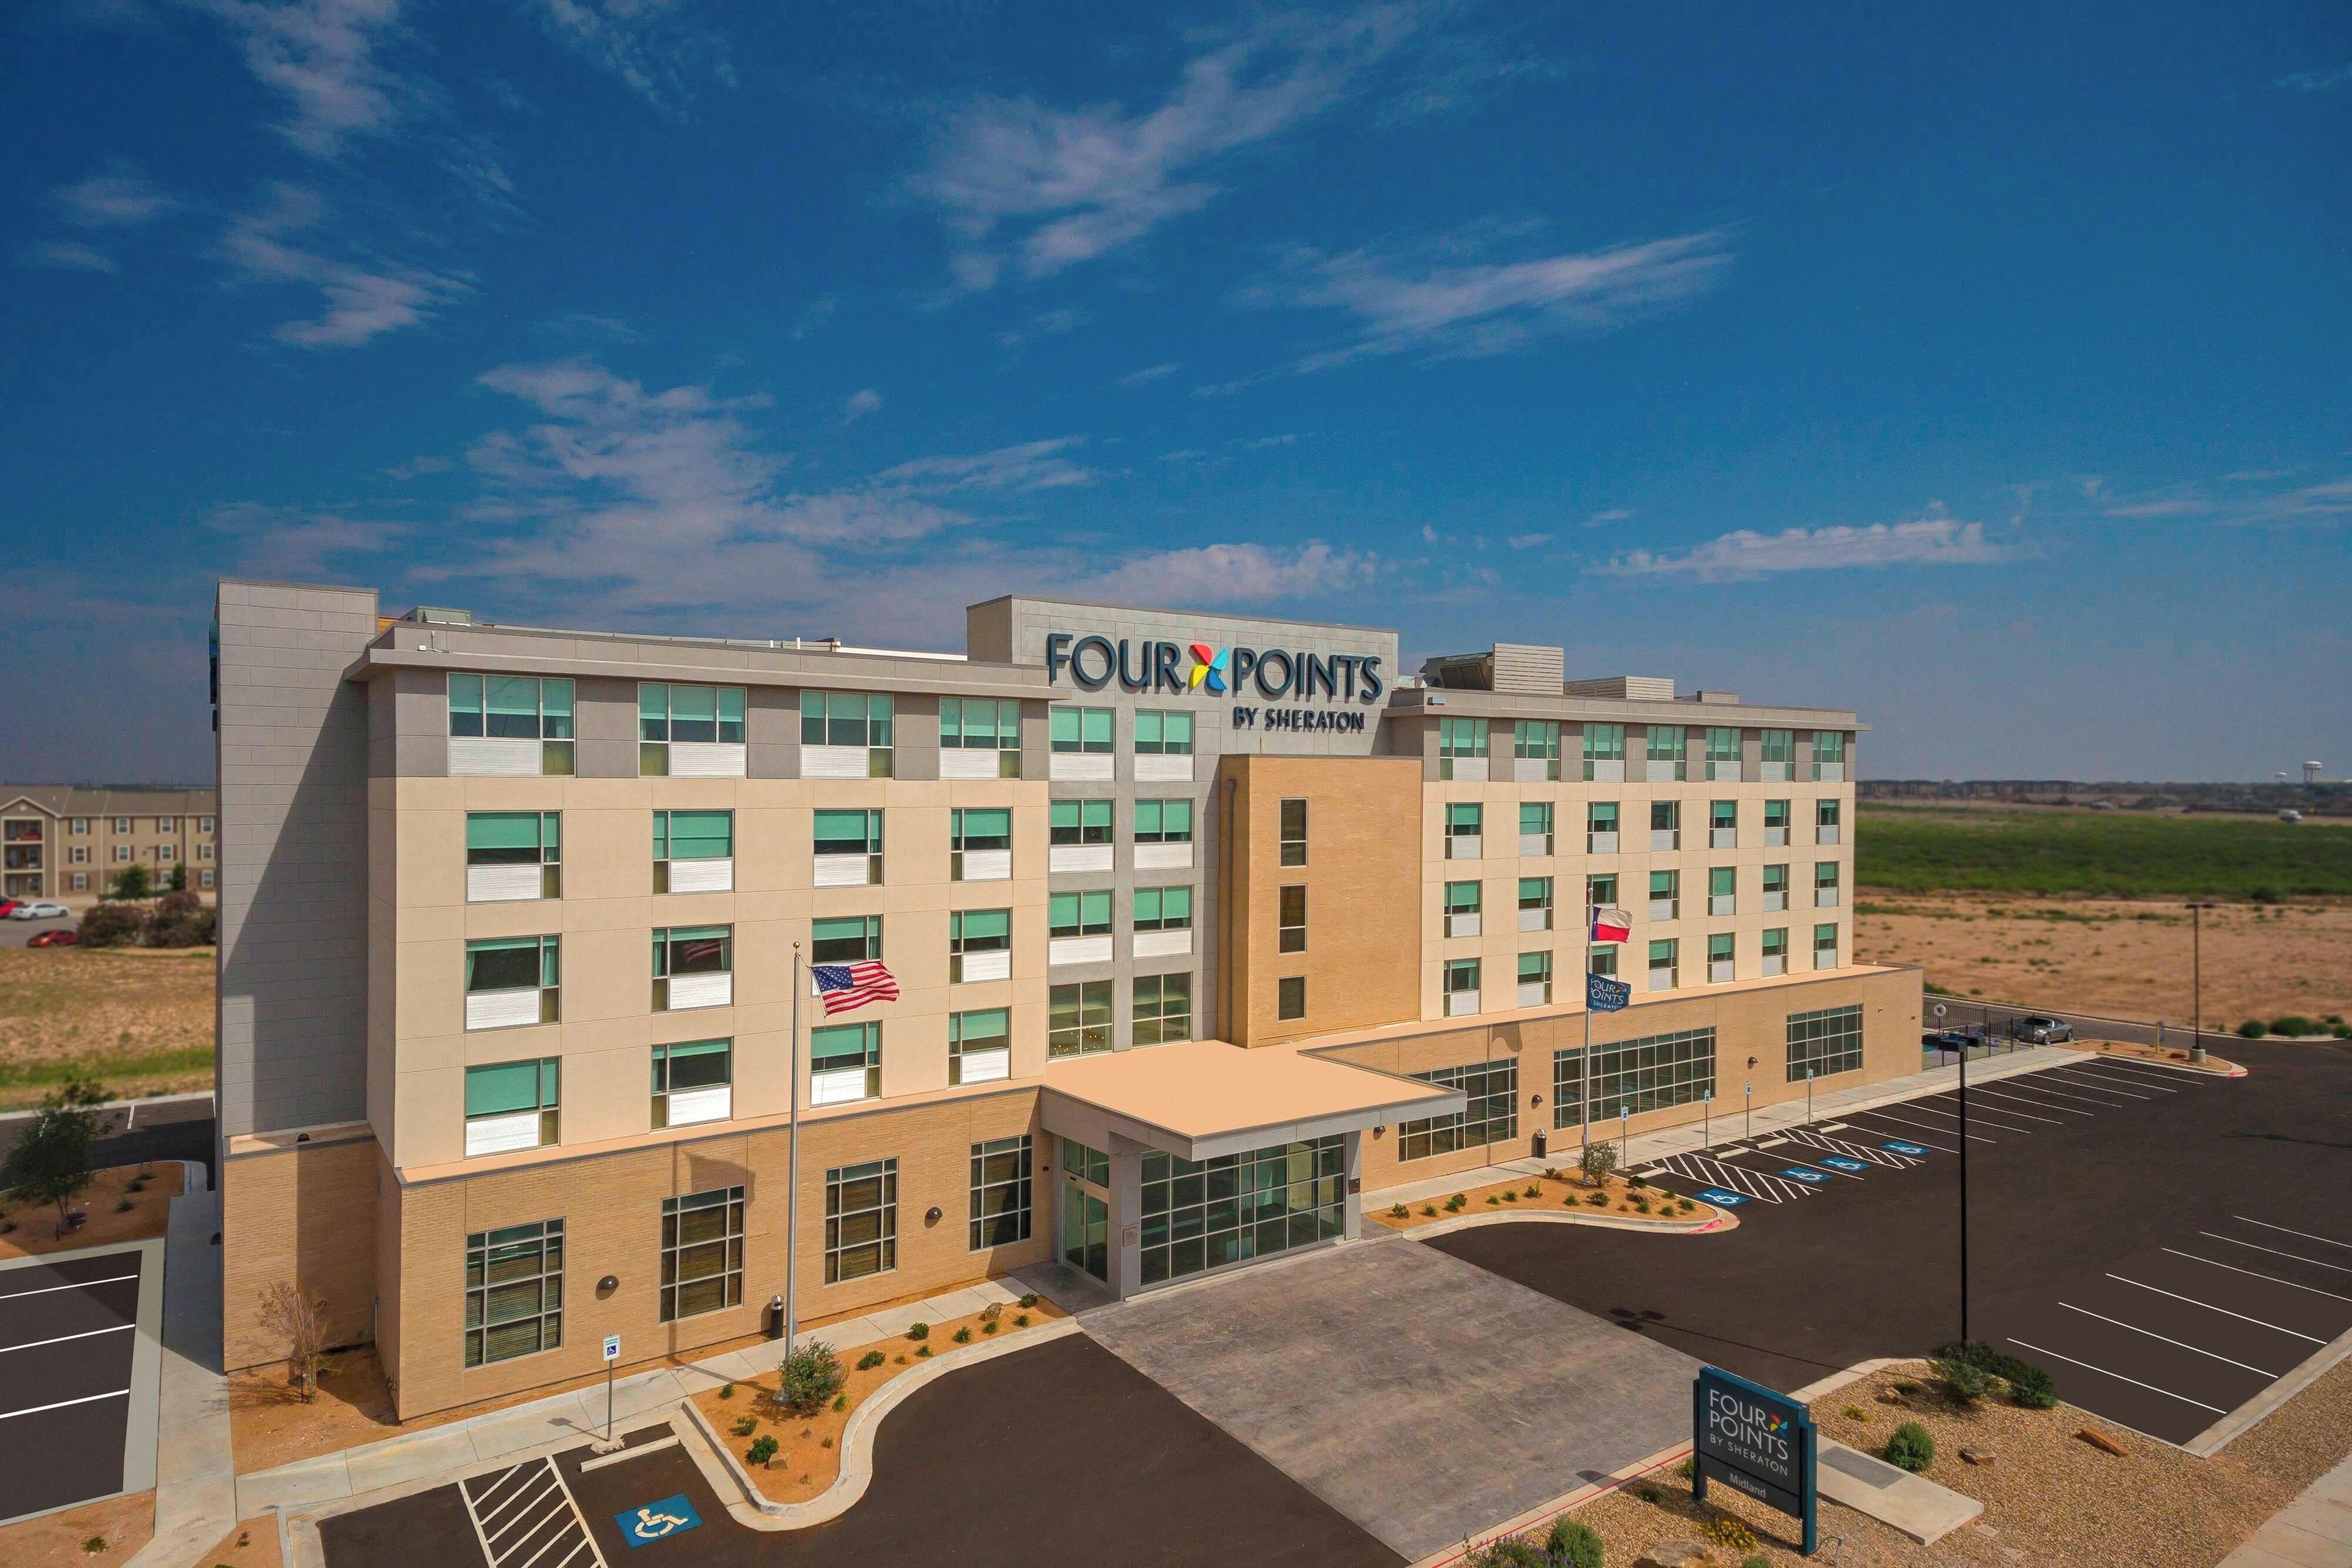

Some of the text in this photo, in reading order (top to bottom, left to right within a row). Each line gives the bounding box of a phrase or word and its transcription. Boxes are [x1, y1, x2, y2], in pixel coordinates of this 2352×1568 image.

[1047, 633, 1382, 699] FOUR POINTS
[1234, 706, 1365, 731] BY SHERATON
[1709, 1389, 1768, 1430] FOUR
[1710, 1410, 1788, 1460] POINTS
[1710, 1433, 1788, 1476] BY SHERATON
[1730, 1472, 1766, 1498] Midland
